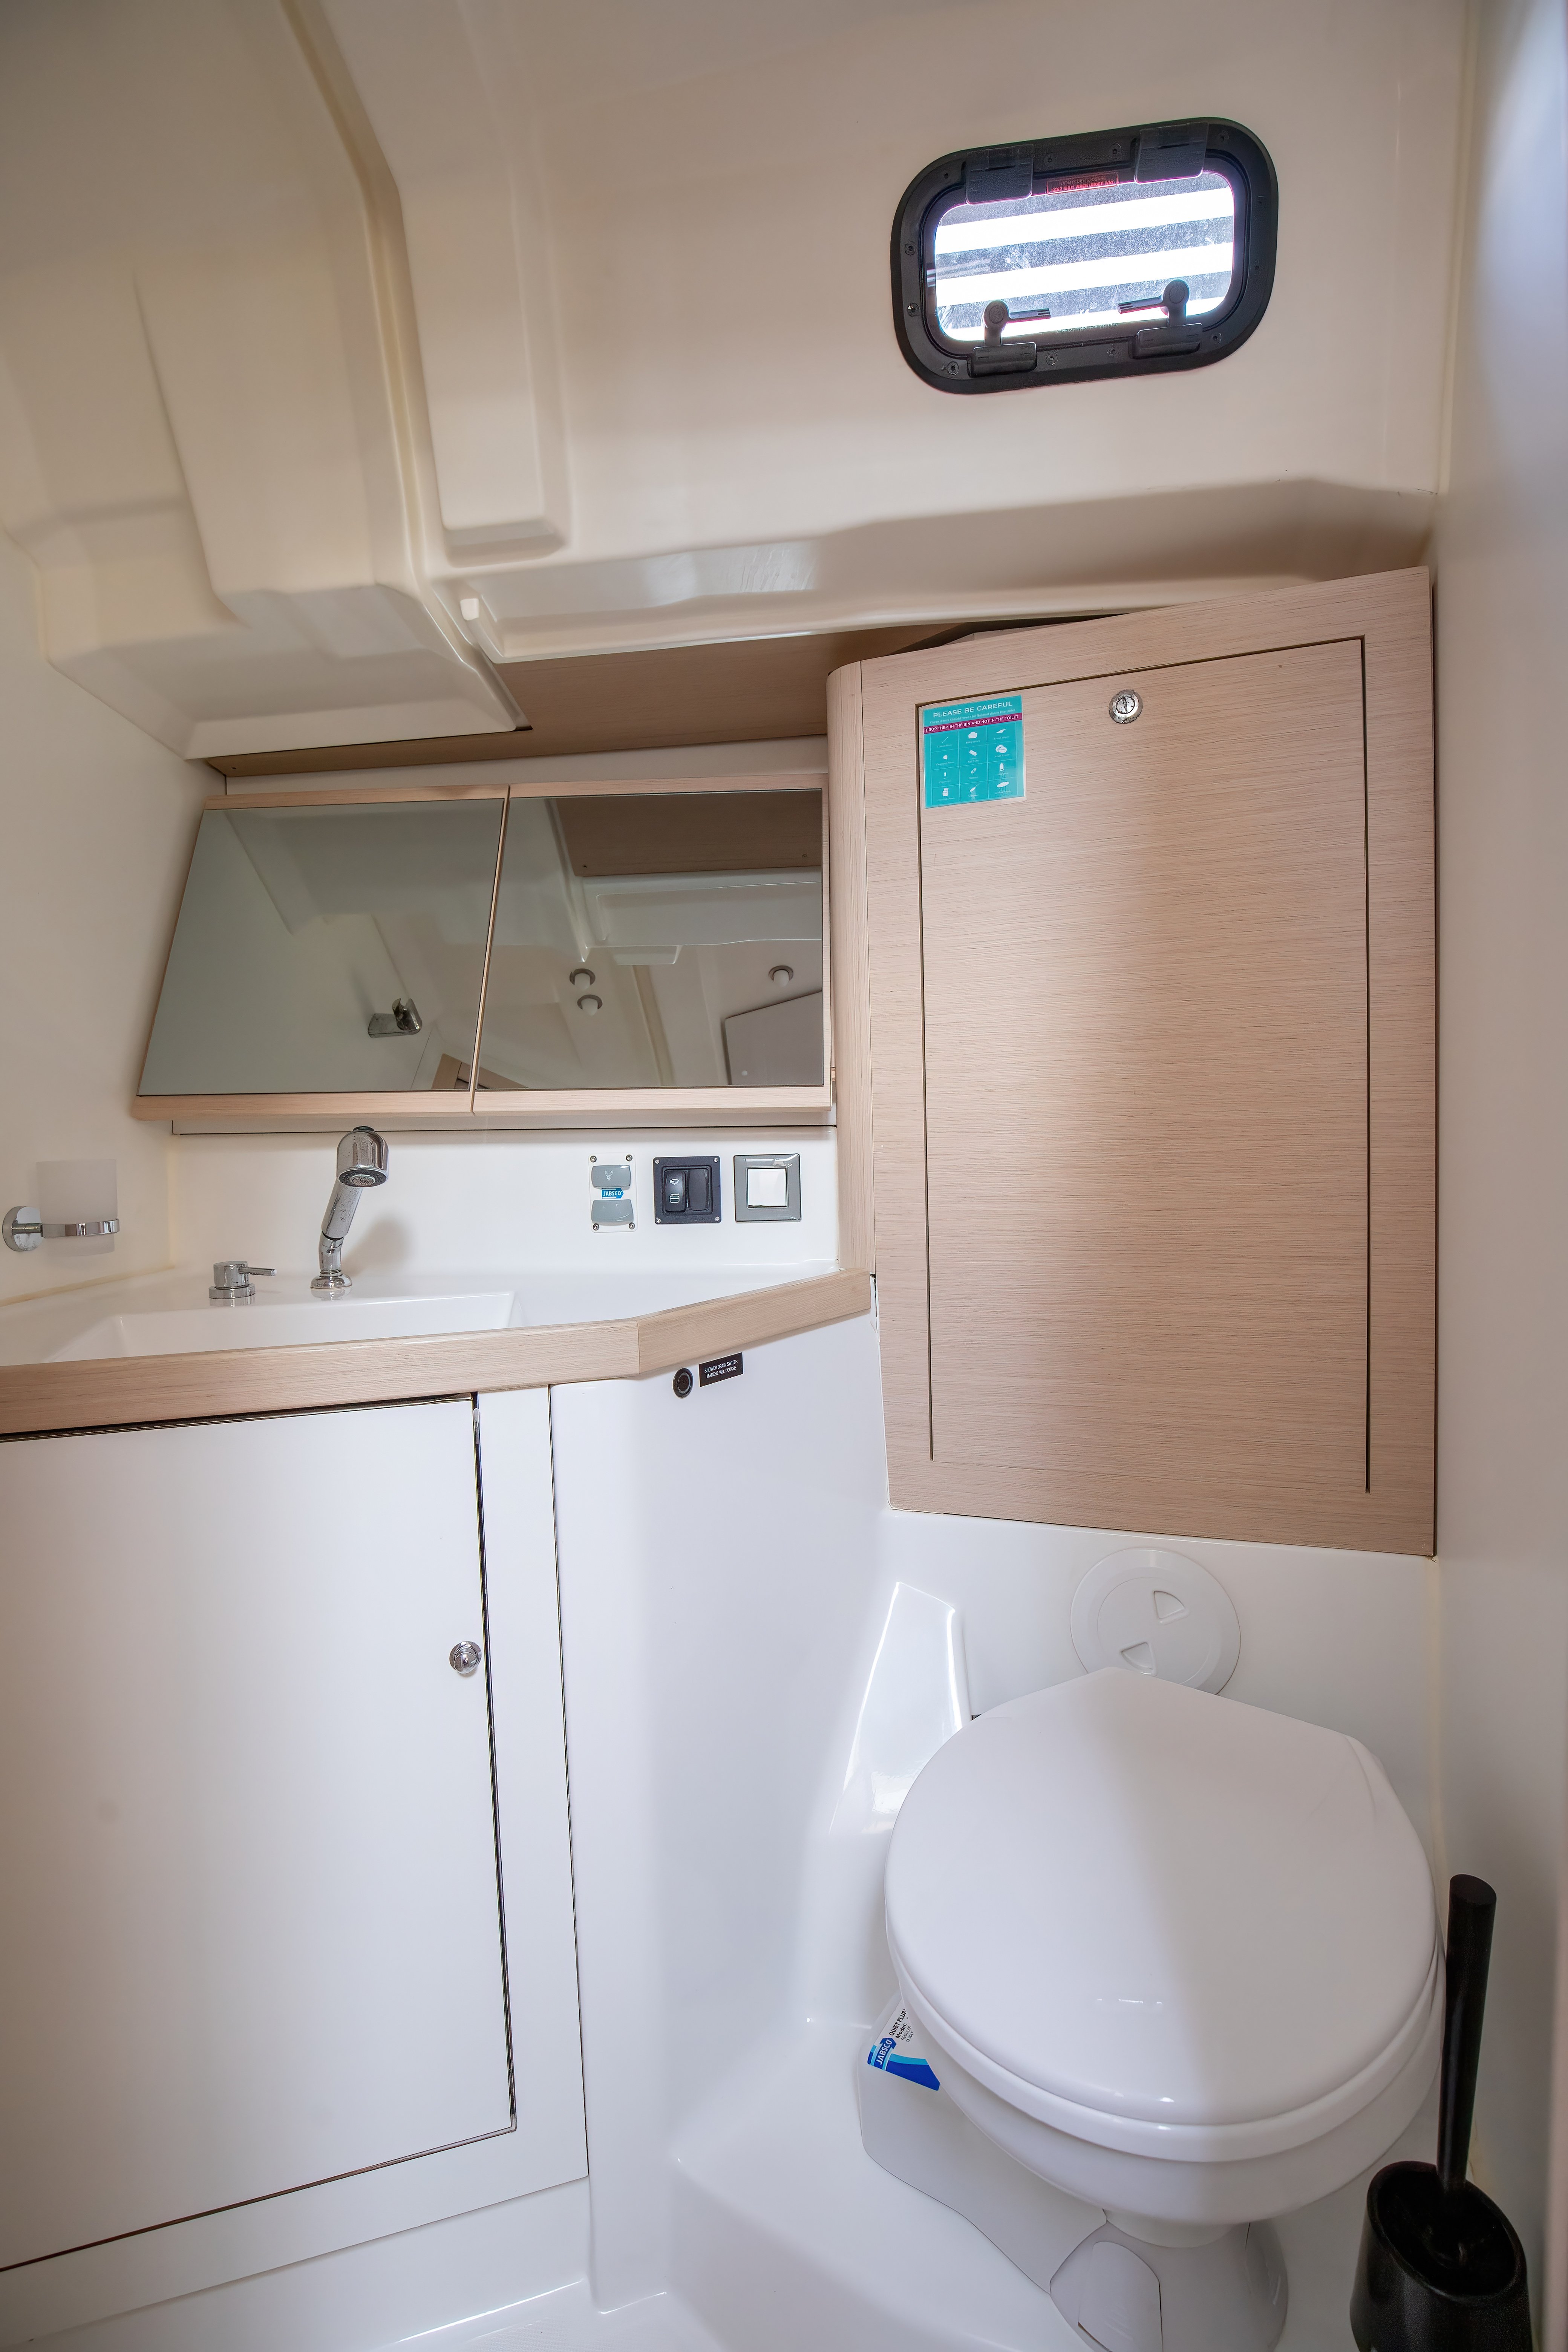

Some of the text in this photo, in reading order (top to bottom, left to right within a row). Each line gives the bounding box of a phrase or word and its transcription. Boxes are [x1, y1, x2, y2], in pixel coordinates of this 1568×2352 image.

[933, 709, 962, 718] PLEASE
[977, 701, 1013, 711] CAREFUL
[889, 2009, 906, 2036] QUIET FLUS
[895, 2023, 908, 2039] Model:
[876, 2040, 892, 2065] JABSCO
